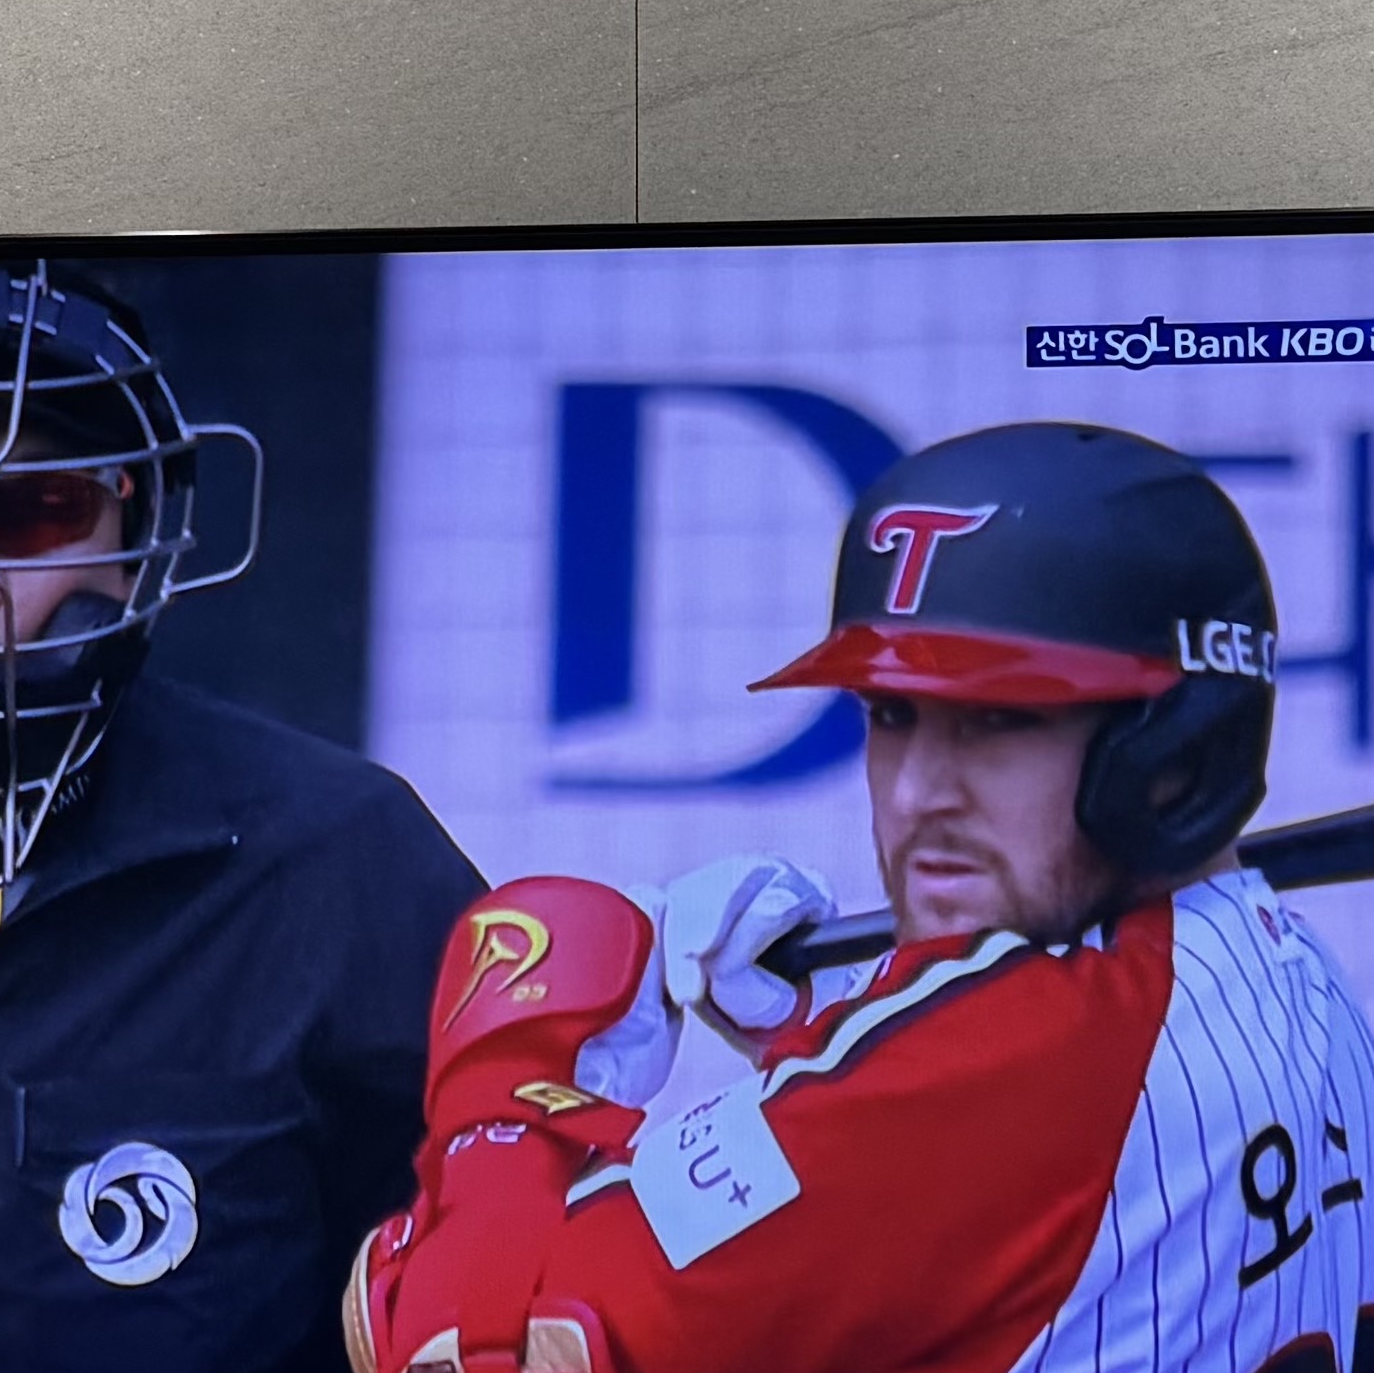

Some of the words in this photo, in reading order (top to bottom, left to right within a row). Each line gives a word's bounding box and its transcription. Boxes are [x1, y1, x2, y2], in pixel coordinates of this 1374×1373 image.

[1036, 329, 1099, 361] 신한
[1174, 327, 1270, 359] Bank
[1280, 327, 1364, 357] KBO
[869, 503, 999, 615] T
